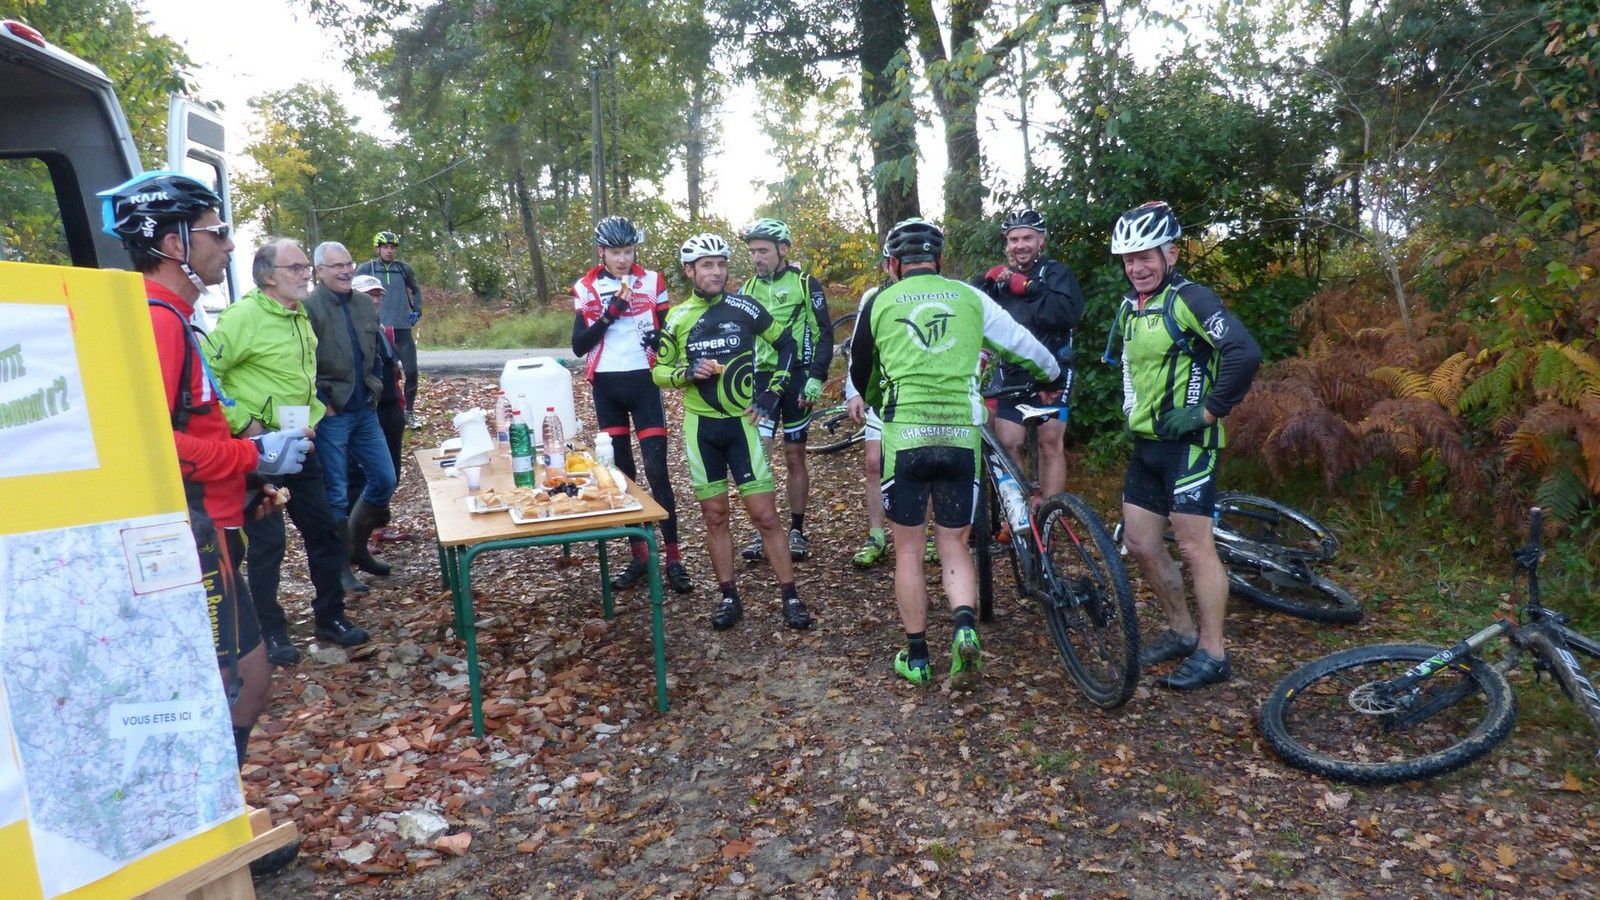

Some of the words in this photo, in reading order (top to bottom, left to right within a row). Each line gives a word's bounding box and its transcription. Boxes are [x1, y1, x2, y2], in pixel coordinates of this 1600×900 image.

[130, 191, 169, 204] KASK
[896, 290, 960, 304] charente
[895, 312, 957, 348] VTT
[687, 338, 726, 351] SUPER
[901, 425, 953, 440] CHARENTE
[953, 427, 971, 439] VTT
[123, 715, 150, 726] VOUS
[153, 712, 176, 723] ETES
[179, 711, 192, 721] ICI
